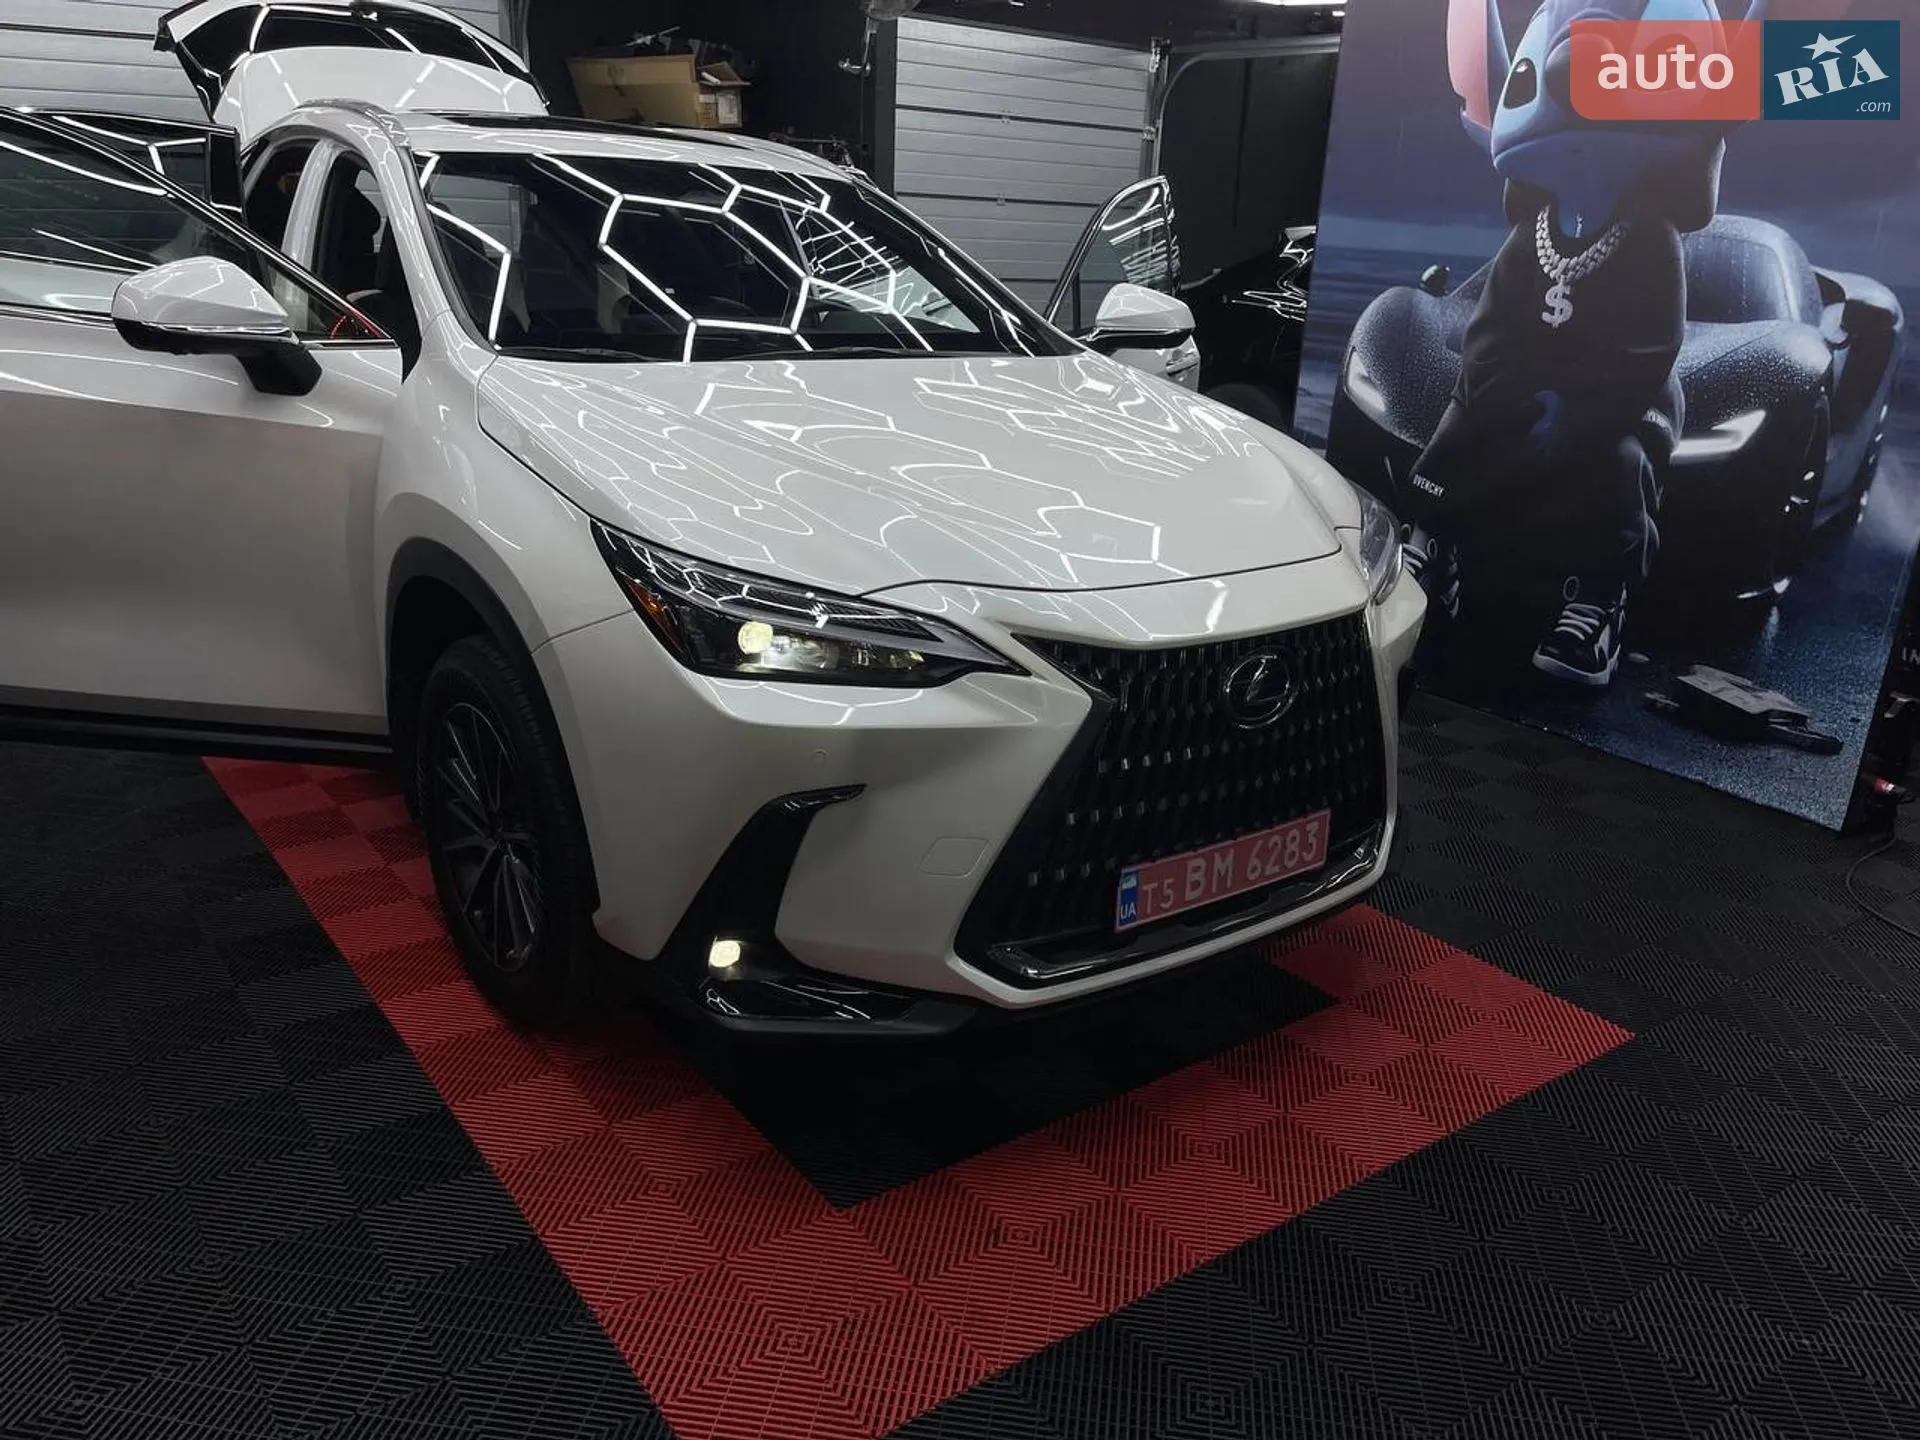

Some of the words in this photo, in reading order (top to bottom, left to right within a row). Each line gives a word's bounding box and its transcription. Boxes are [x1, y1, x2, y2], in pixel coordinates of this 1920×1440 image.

[1142, 877, 1175, 914] T5
[1185, 847, 1235, 901] BM
[1245, 820, 1320, 881] 6283
[1120, 901, 1137, 920] UA
